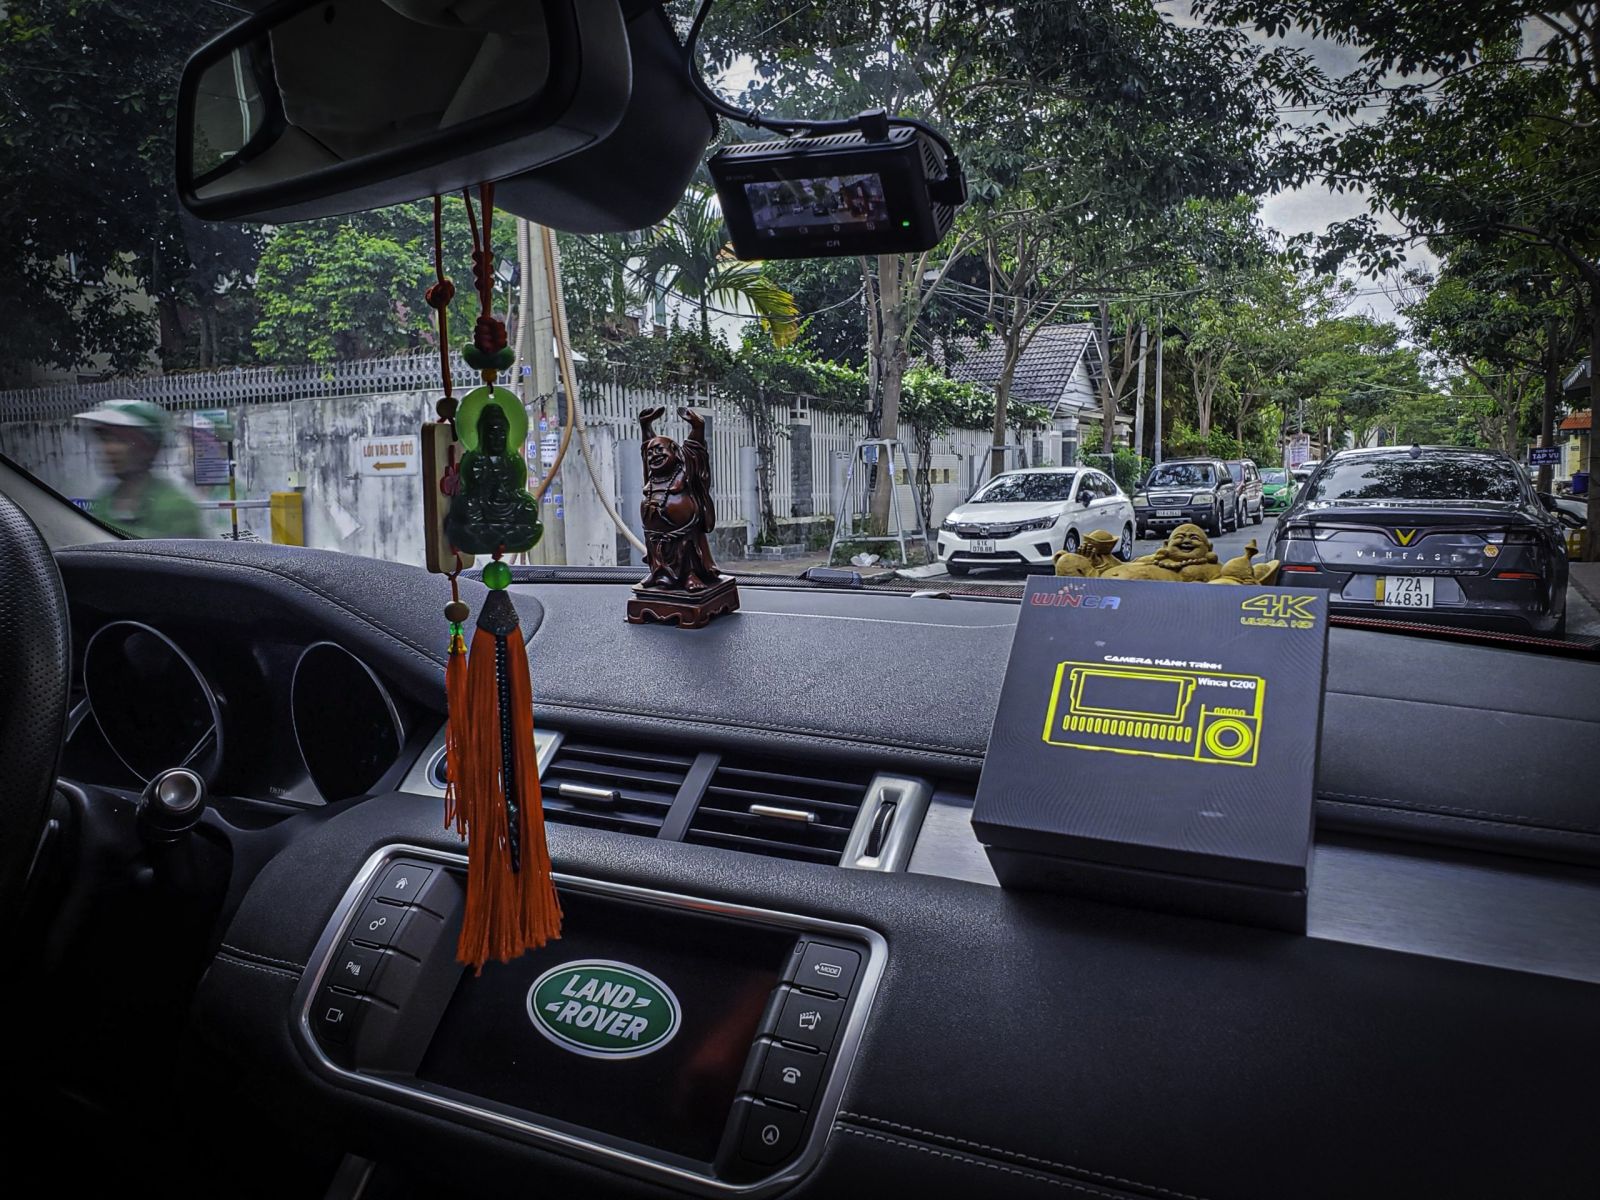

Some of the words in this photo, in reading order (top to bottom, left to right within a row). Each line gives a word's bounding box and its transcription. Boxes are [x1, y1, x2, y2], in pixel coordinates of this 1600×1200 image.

[1356, 550, 1459, 562] VINFAST
[1396, 577, 1422, 592] 72A
[1241, 594, 1319, 619] 4K
[1386, 593, 1430, 608] 448.31
[1240, 616, 1289, 628] ULTRA
[1103, 655, 1153, 665] CAMERA
[1154, 658, 1187, 668] HÀNH
[1189, 661, 1222, 670] TRÌNH
[1197, 677, 1228, 688] Winca
[1229, 679, 1256, 690] C200
[561, 974, 637, 1009] LAND
[556, 999, 649, 1042] ROVER
